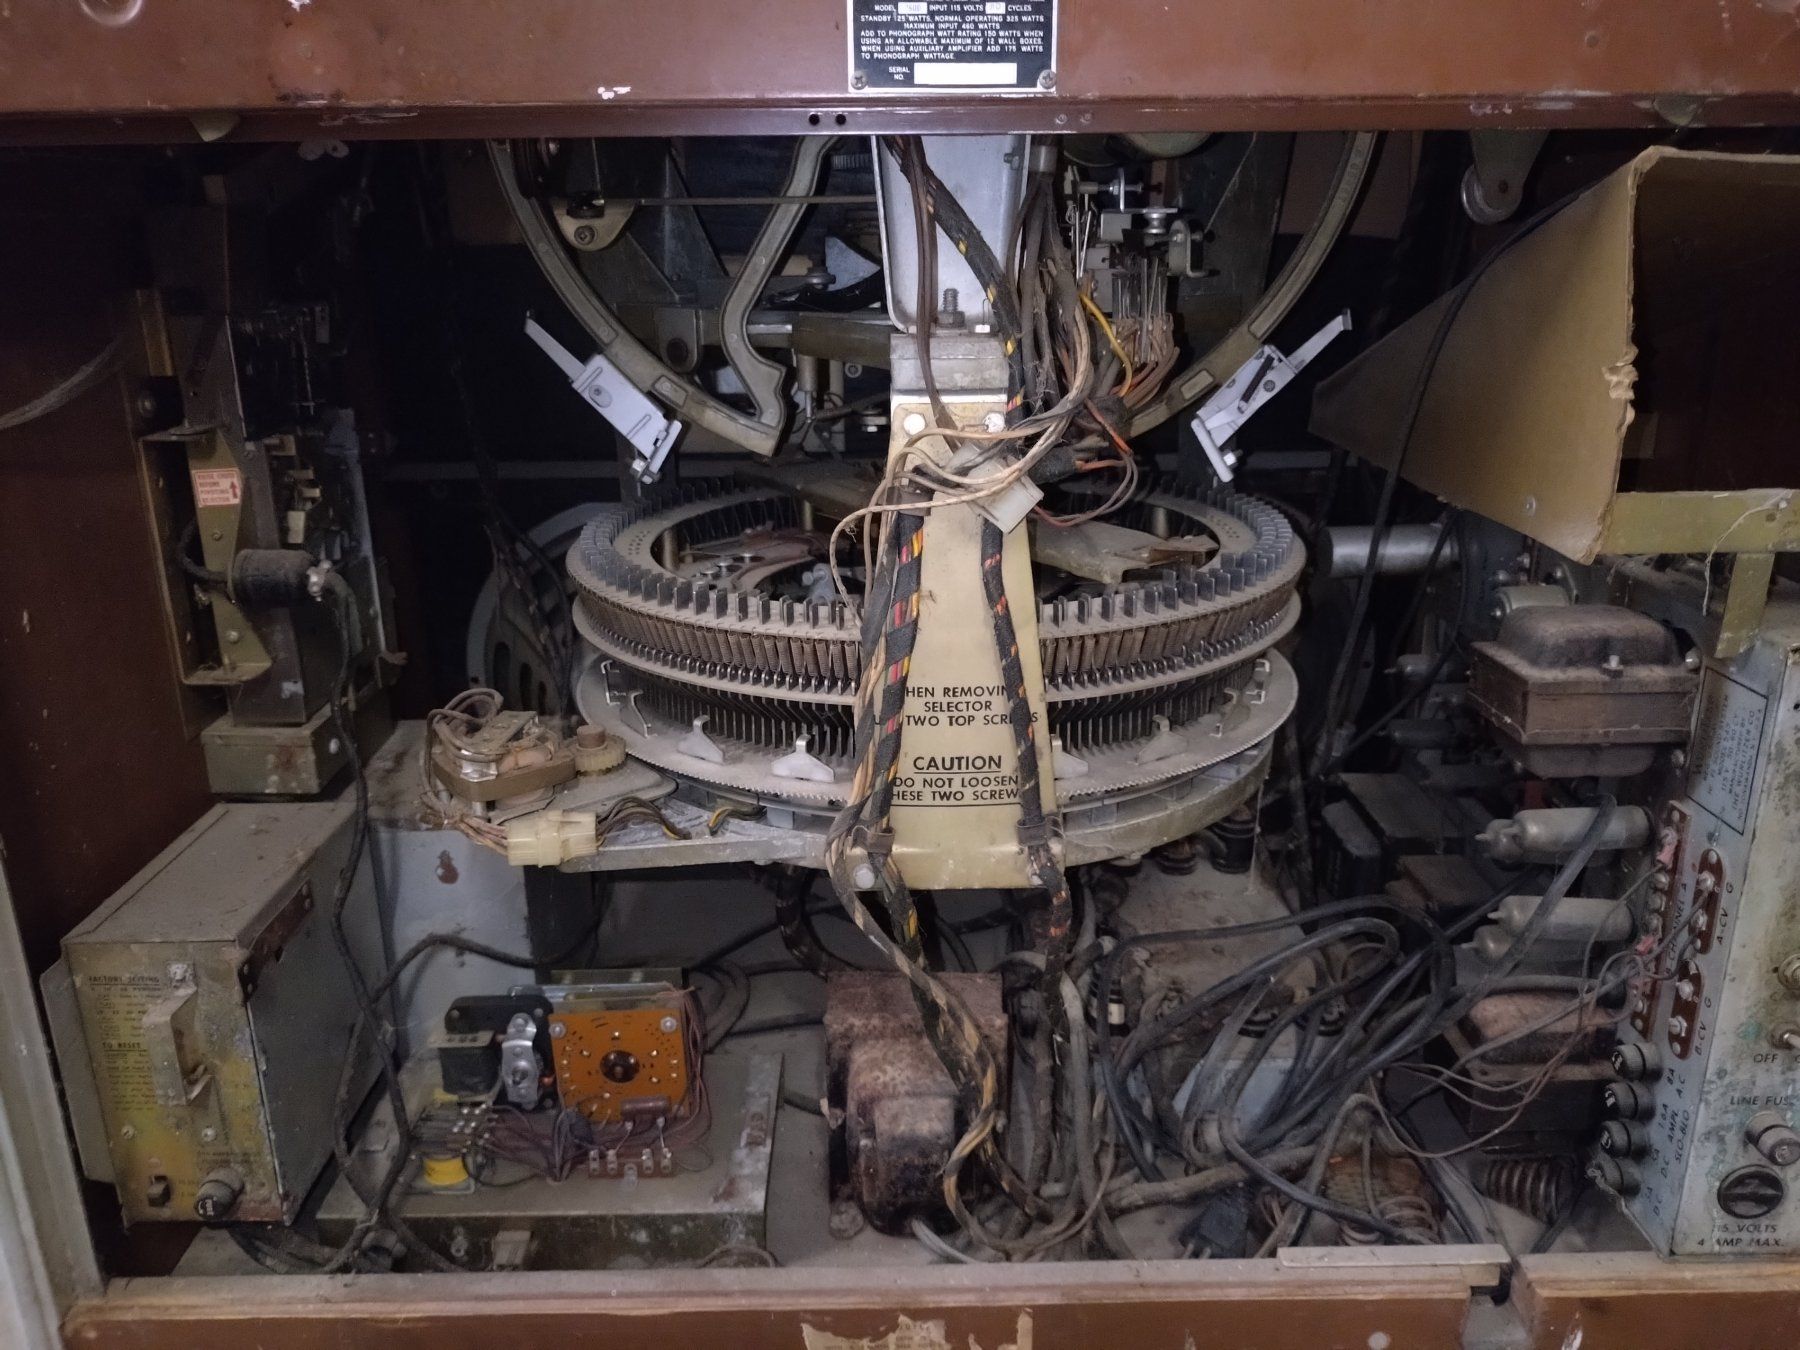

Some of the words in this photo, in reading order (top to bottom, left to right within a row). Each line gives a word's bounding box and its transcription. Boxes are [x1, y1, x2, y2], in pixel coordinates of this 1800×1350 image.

[906, 686, 934, 698] HEN
[943, 686, 1006, 698] REMOVIN
[924, 700, 992, 712] SELECTOR
[906, 715, 939, 726] TWO
[949, 715, 975, 726] TOP
[983, 712, 1038, 725] SCRS
[913, 756, 1001, 770] CAUTION
[894, 777, 915, 788] DO
[922, 778, 954, 788] NOT
[961, 775, 1018, 787] LOOSEN
[892, 791, 923, 801] HESE
[932, 791, 964, 801] TWO
[972, 788, 1019, 800] SCREW
[1753, 1053, 1778, 1063] OFF
[1730, 1096, 1760, 1105] LINE
[1737, 1224, 1777, 1233] VOLTS
[1698, 1237, 1704, 1246] 4
